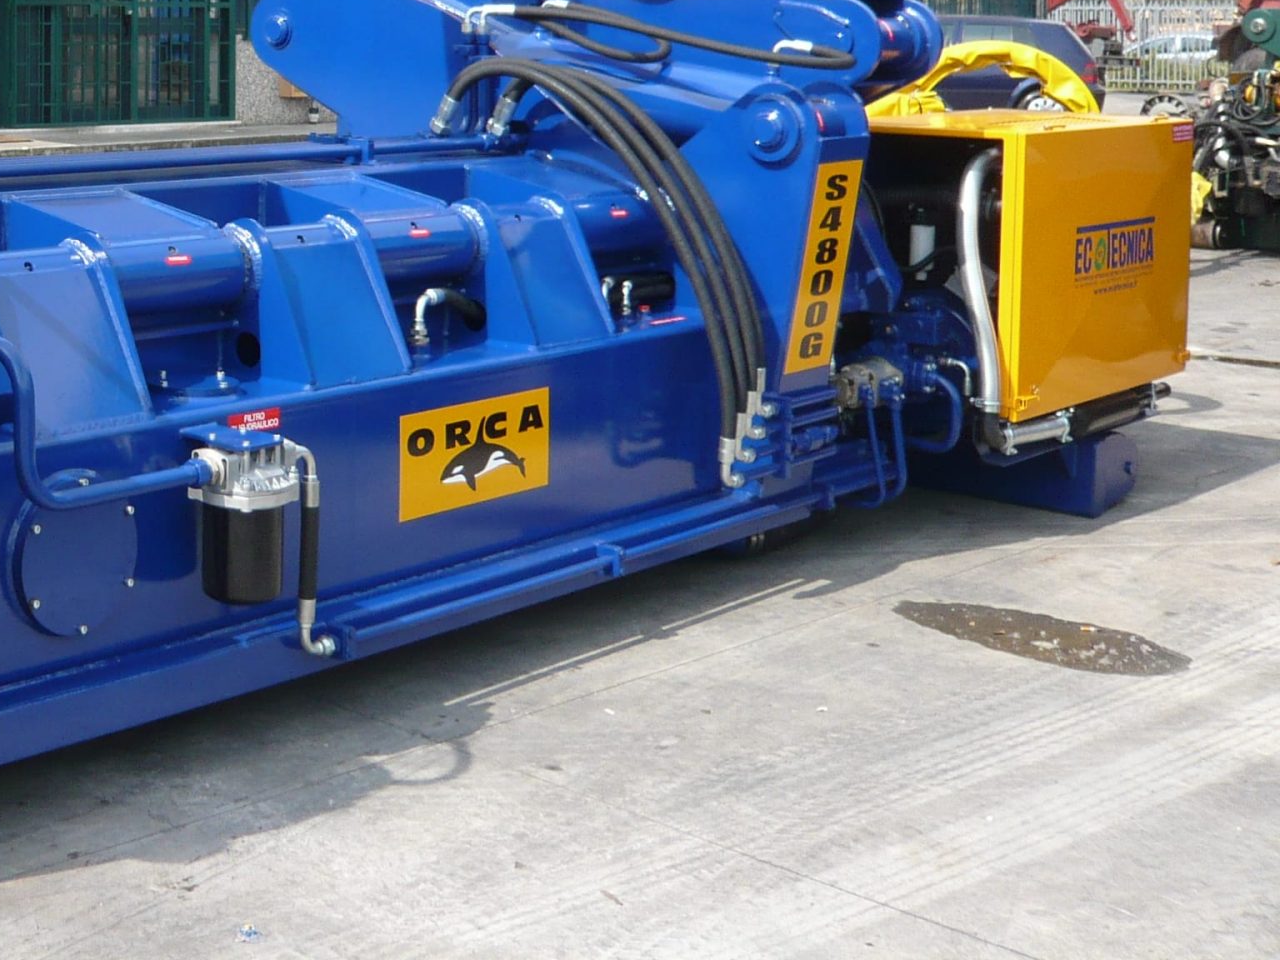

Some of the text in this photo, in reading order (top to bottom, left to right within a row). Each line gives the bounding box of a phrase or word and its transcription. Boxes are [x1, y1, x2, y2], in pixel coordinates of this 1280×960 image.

[799, 174, 848, 359] S4800G
[243, 411, 265, 423] FILTRO
[407, 404, 544, 457] ORCA
